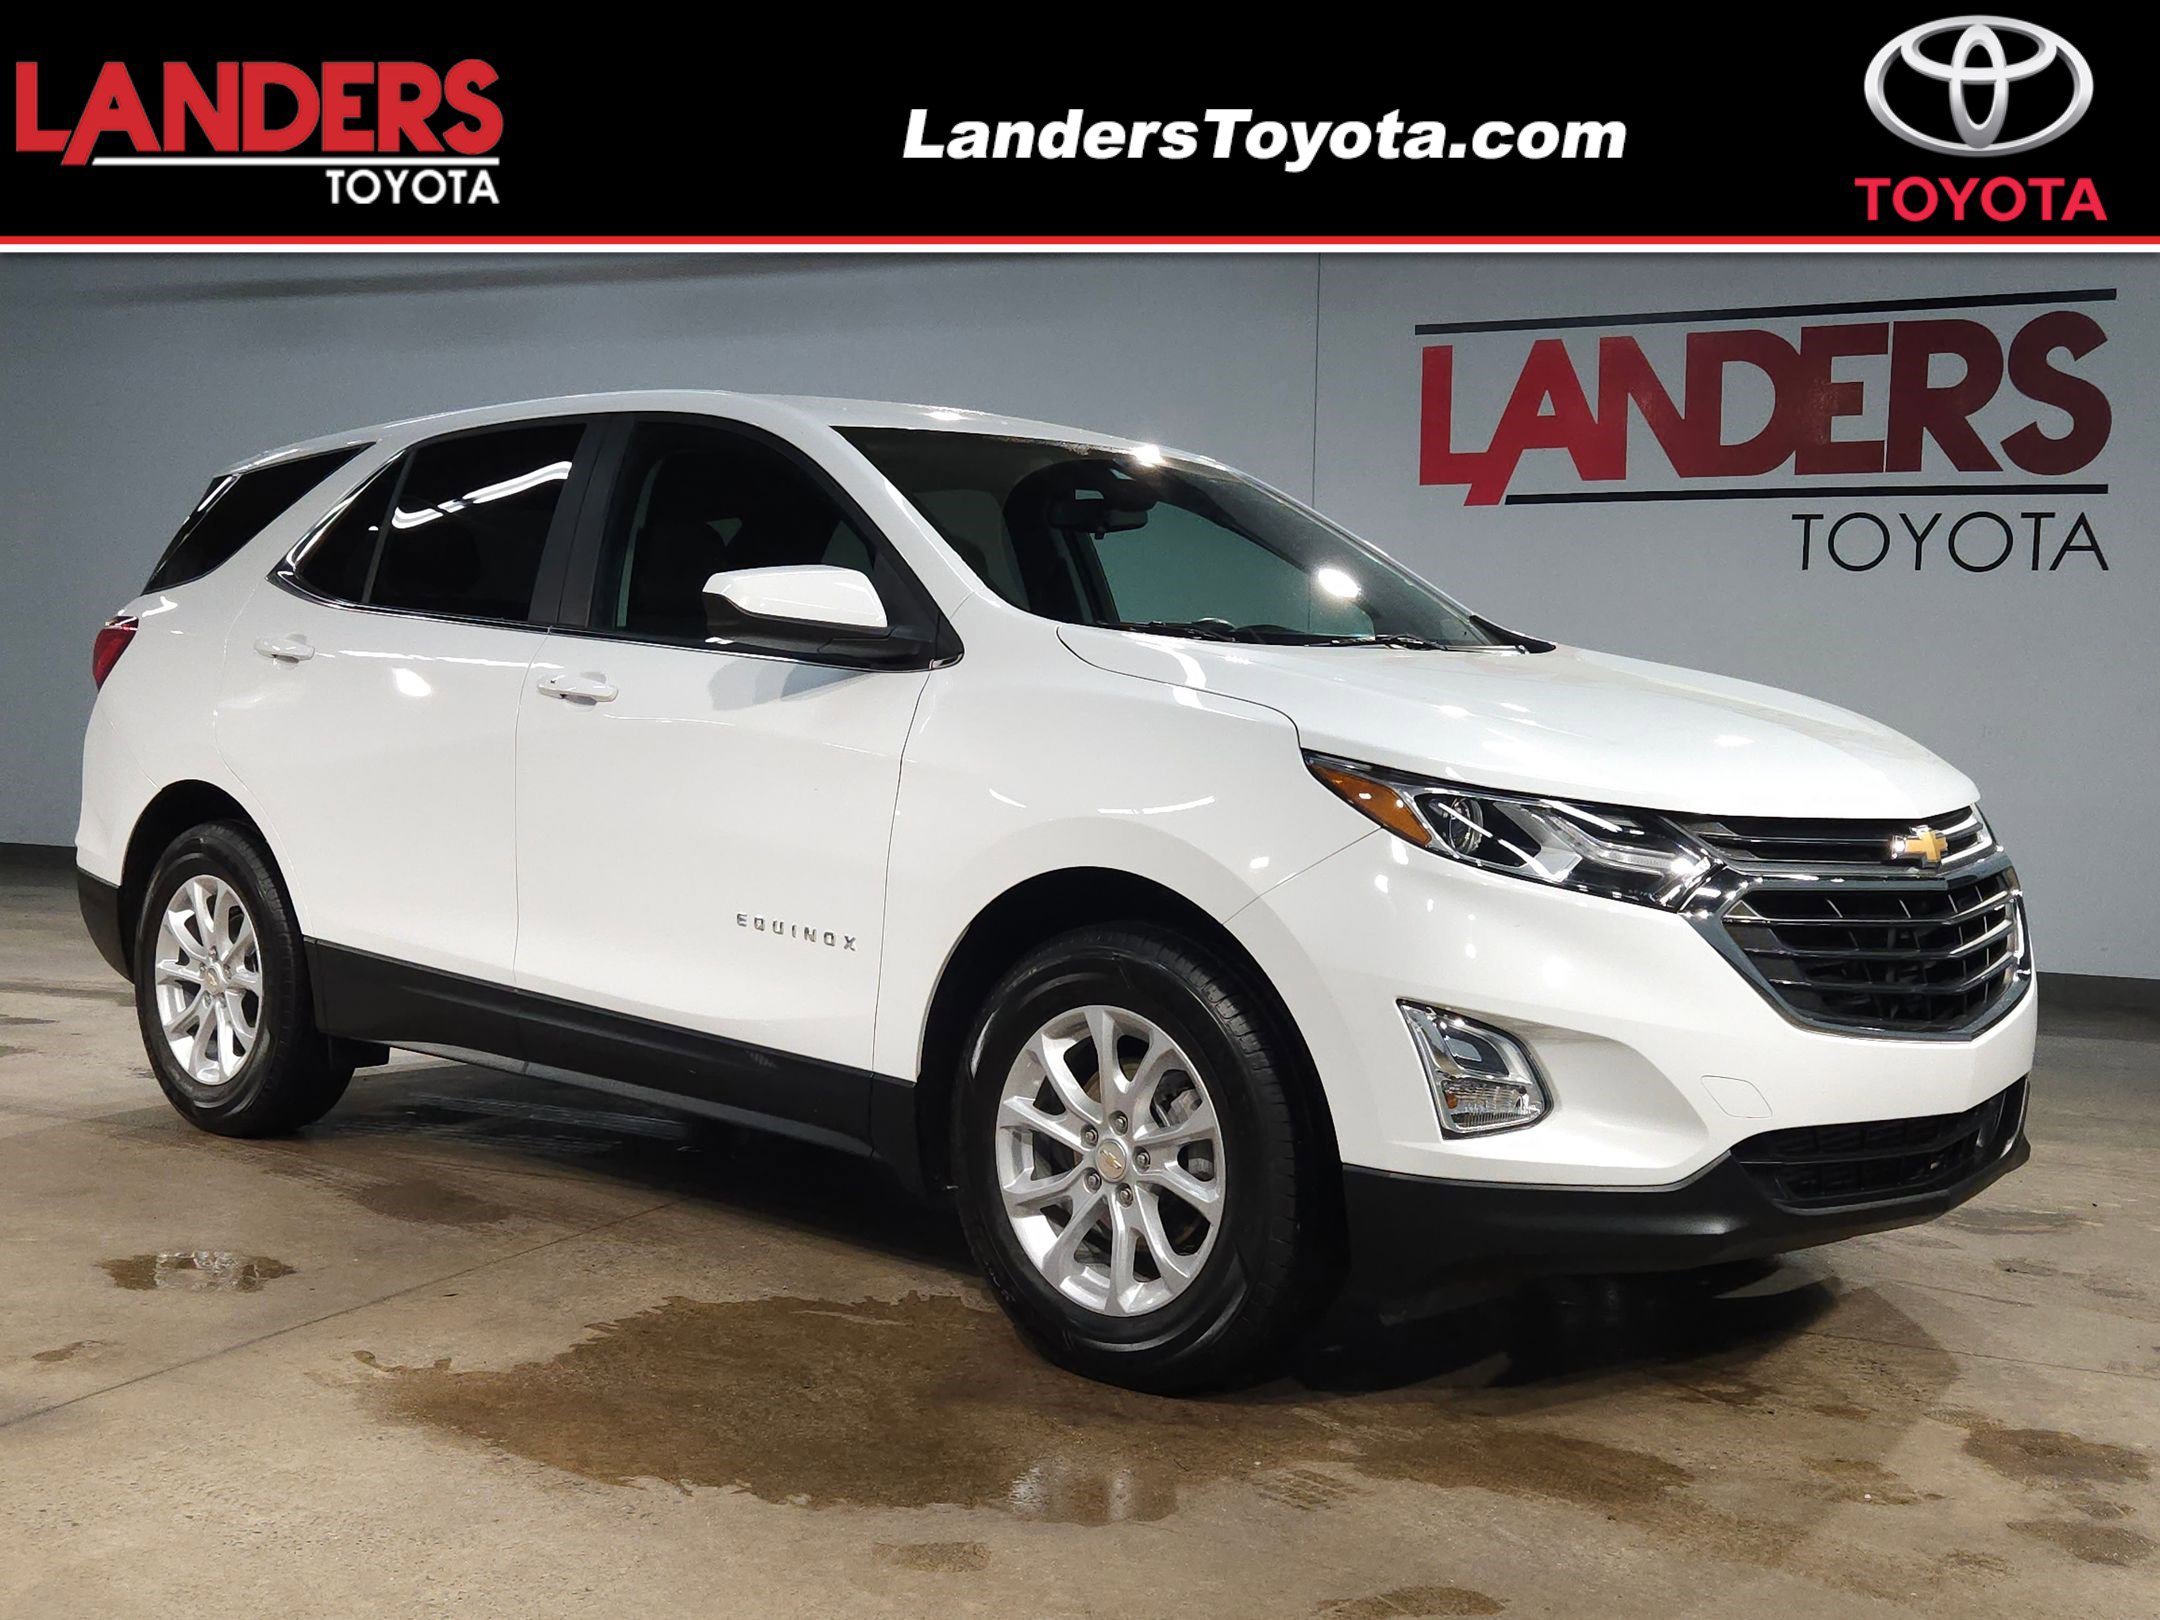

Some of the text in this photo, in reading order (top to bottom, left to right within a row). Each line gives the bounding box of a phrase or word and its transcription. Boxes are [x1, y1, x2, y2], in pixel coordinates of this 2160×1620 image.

[1419, 310, 2112, 506] LANDERS
[1791, 511, 2109, 572] TOYOTA
[736, 913, 856, 952] EQUINOX
